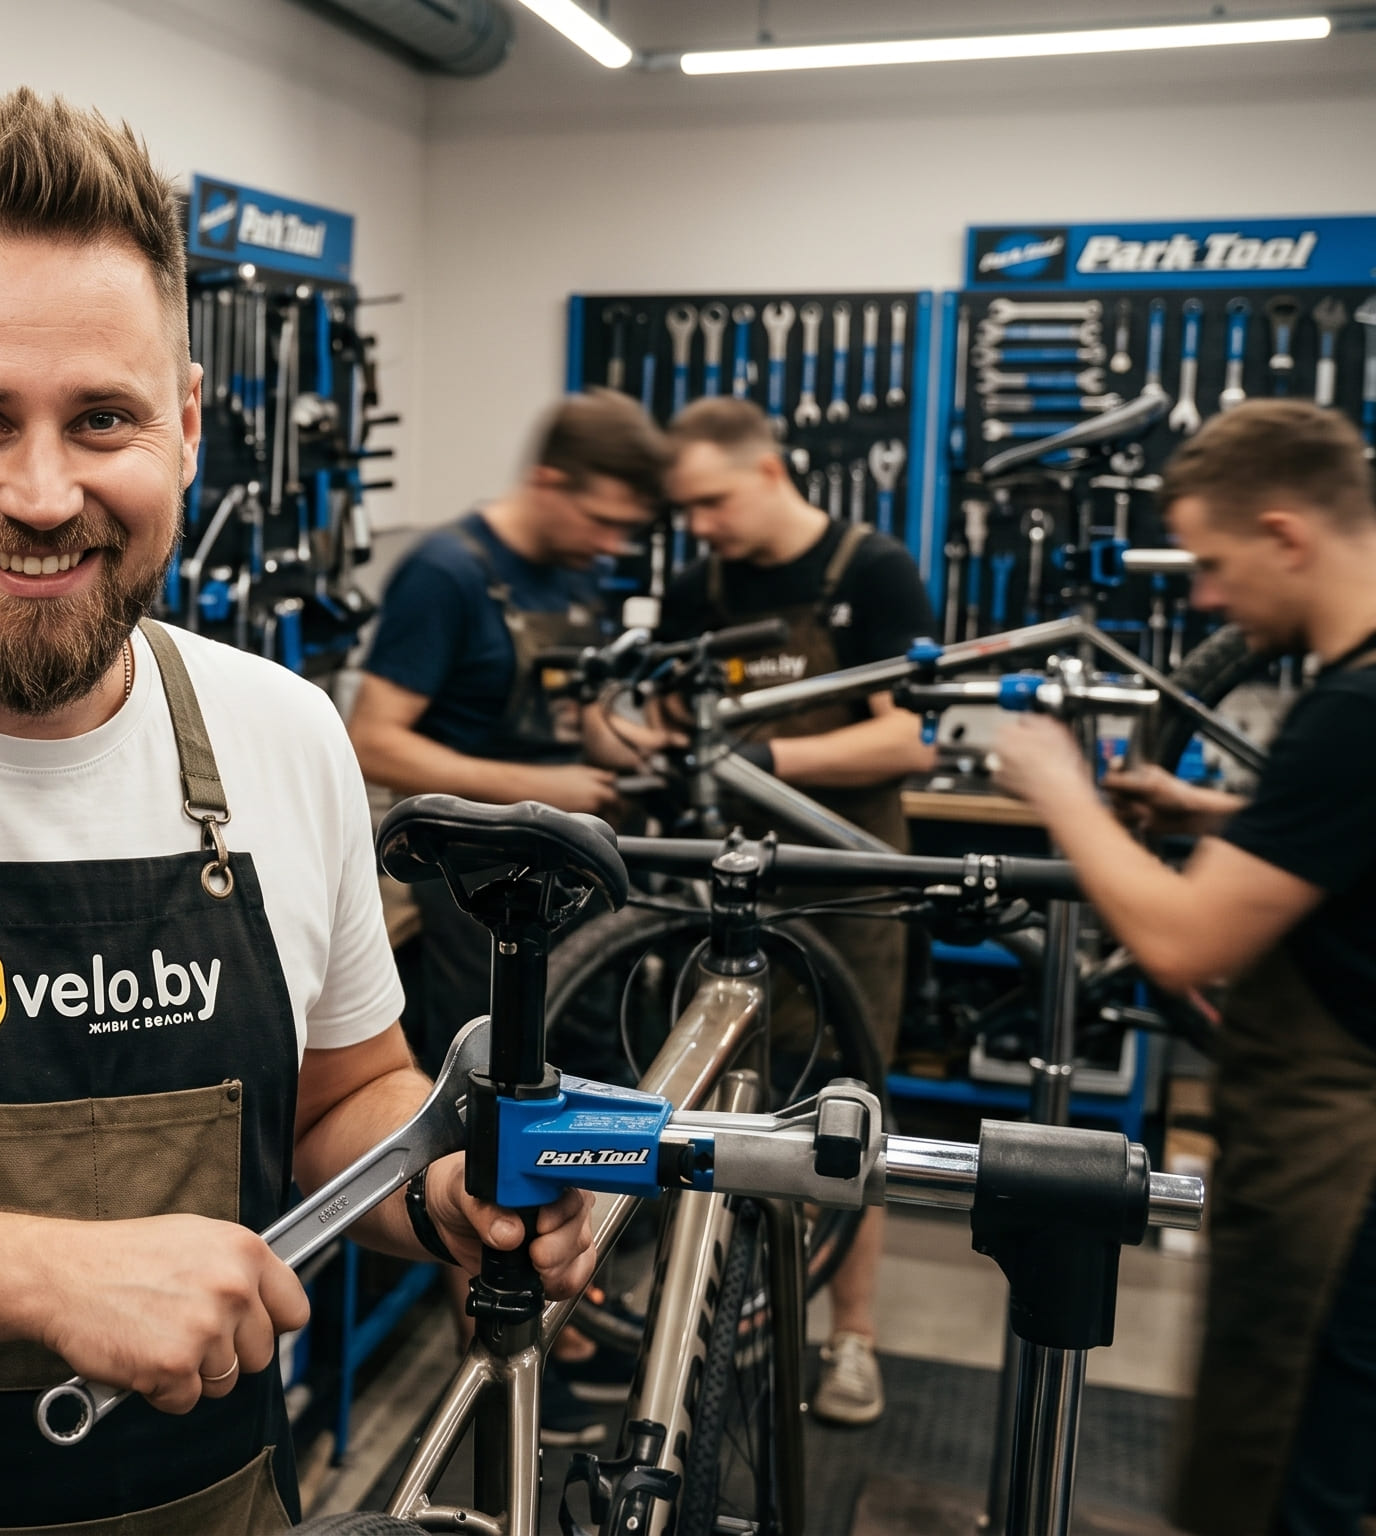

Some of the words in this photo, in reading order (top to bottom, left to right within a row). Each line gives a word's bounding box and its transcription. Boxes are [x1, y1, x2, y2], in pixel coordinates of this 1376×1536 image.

[1076, 233, 1199, 274] Park
[1203, 230, 1318, 270] Tool
[12, 949, 222, 1021] velo.by
[88, 1020, 129, 1034] живи
[144, 1011, 194, 1028] велом
[536, 1150, 595, 1166] Park
[597, 1149, 650, 1165] Tool
